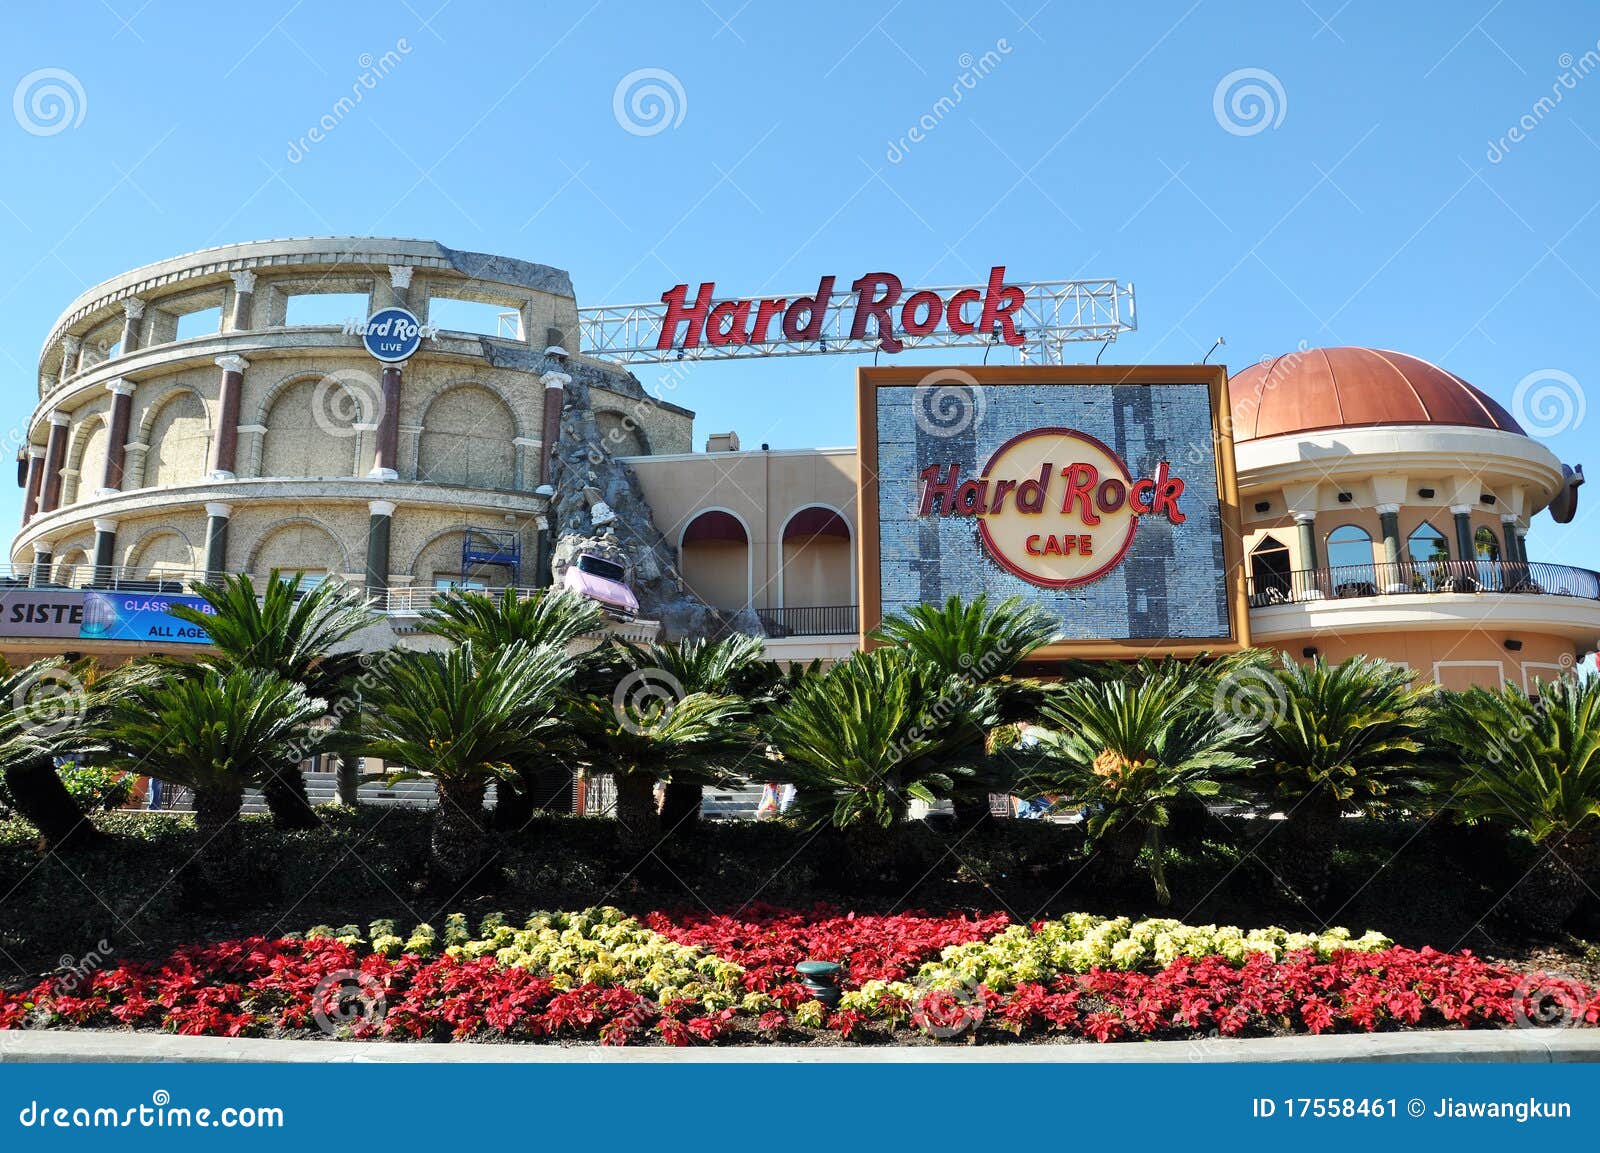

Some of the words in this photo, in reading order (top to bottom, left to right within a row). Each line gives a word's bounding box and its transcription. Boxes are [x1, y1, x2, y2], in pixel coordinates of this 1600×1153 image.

[656, 276, 836, 350] Hard
[850, 265, 1026, 354] Rock
[341, 317, 393, 336] Hard
[393, 318, 440, 341] Rock
[380, 343, 402, 352] LIVE
[918, 463, 1053, 517] Hard
[1060, 462, 1186, 525] Rock
[1025, 534, 1093, 556] CAFE
[124, 600, 172, 613] CLASS
[148, 625, 174, 637] ALL
